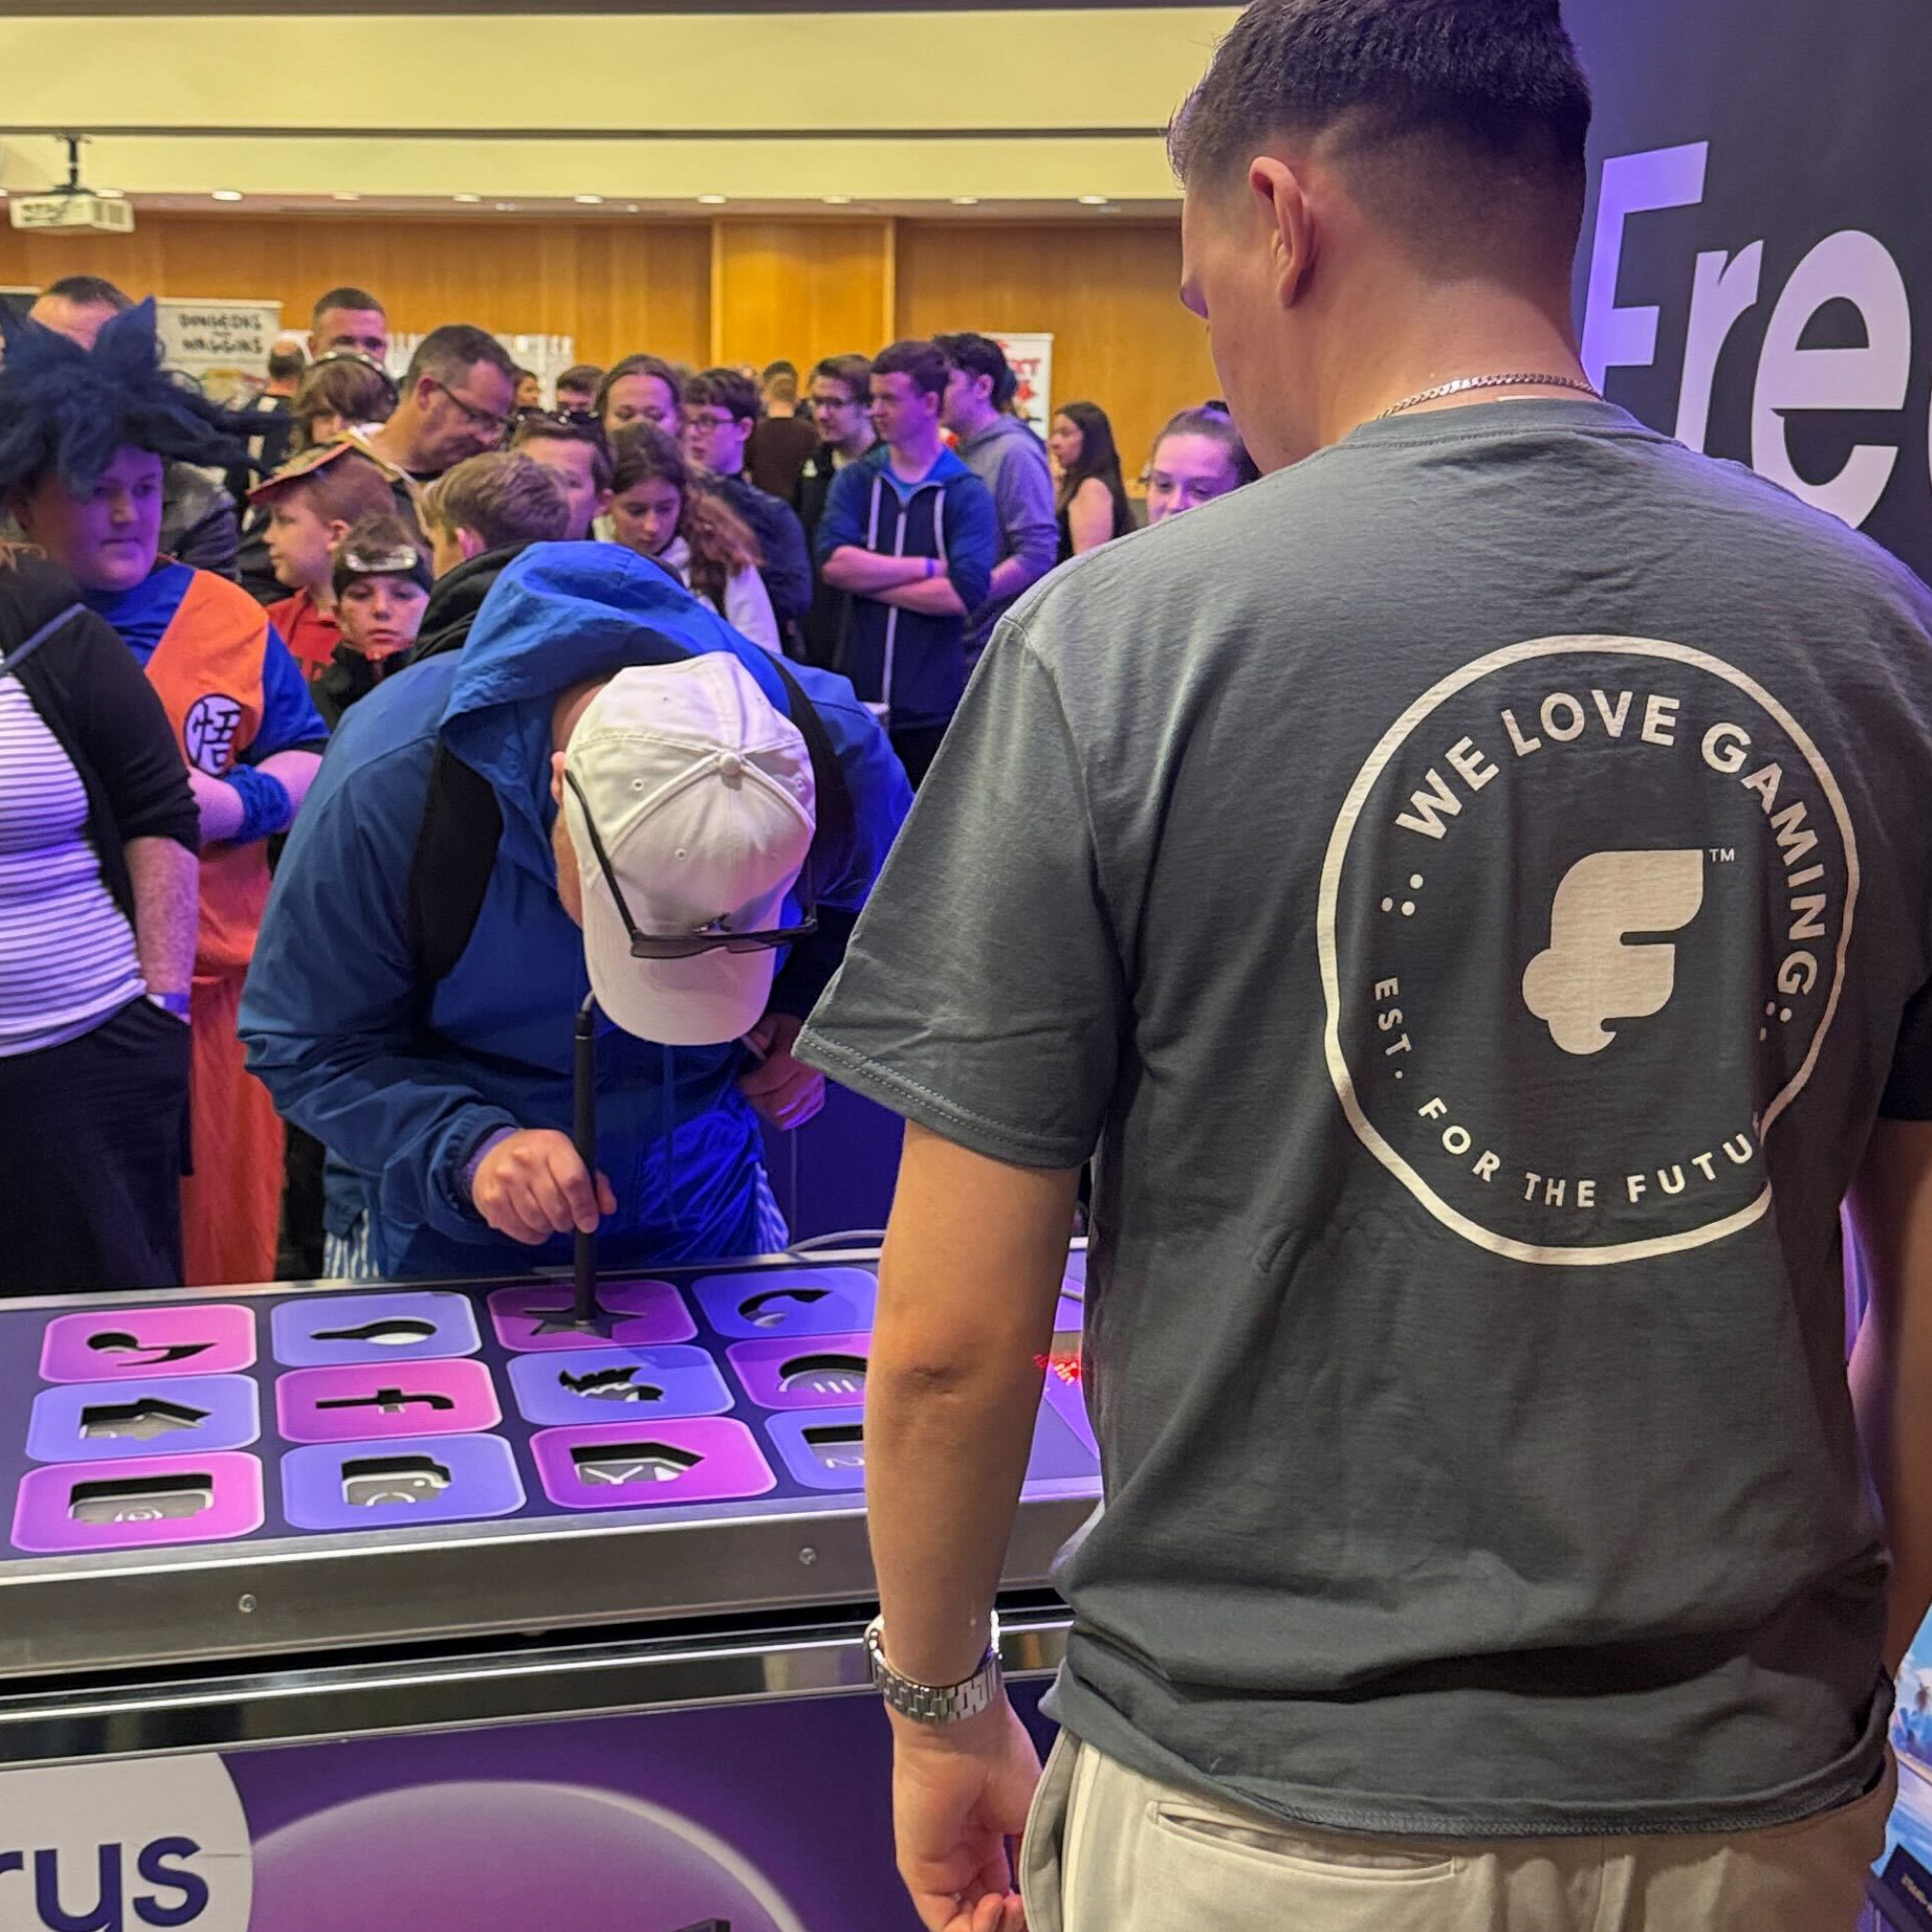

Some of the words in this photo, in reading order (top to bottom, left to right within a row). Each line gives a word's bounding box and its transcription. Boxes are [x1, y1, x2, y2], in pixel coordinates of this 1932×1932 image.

[1579, 141, 1932, 529] Fre
[1395, 735, 1500, 840] WE
[1500, 689, 1681, 757] LOVE
[1700, 722, 1827, 996] GAMING
[1708, 847, 1735, 863] TM
[1417, 1096, 1501, 1182] FOR
[1523, 1172, 1597, 1208] THE
[1626, 1113, 1760, 1204] FUTU
